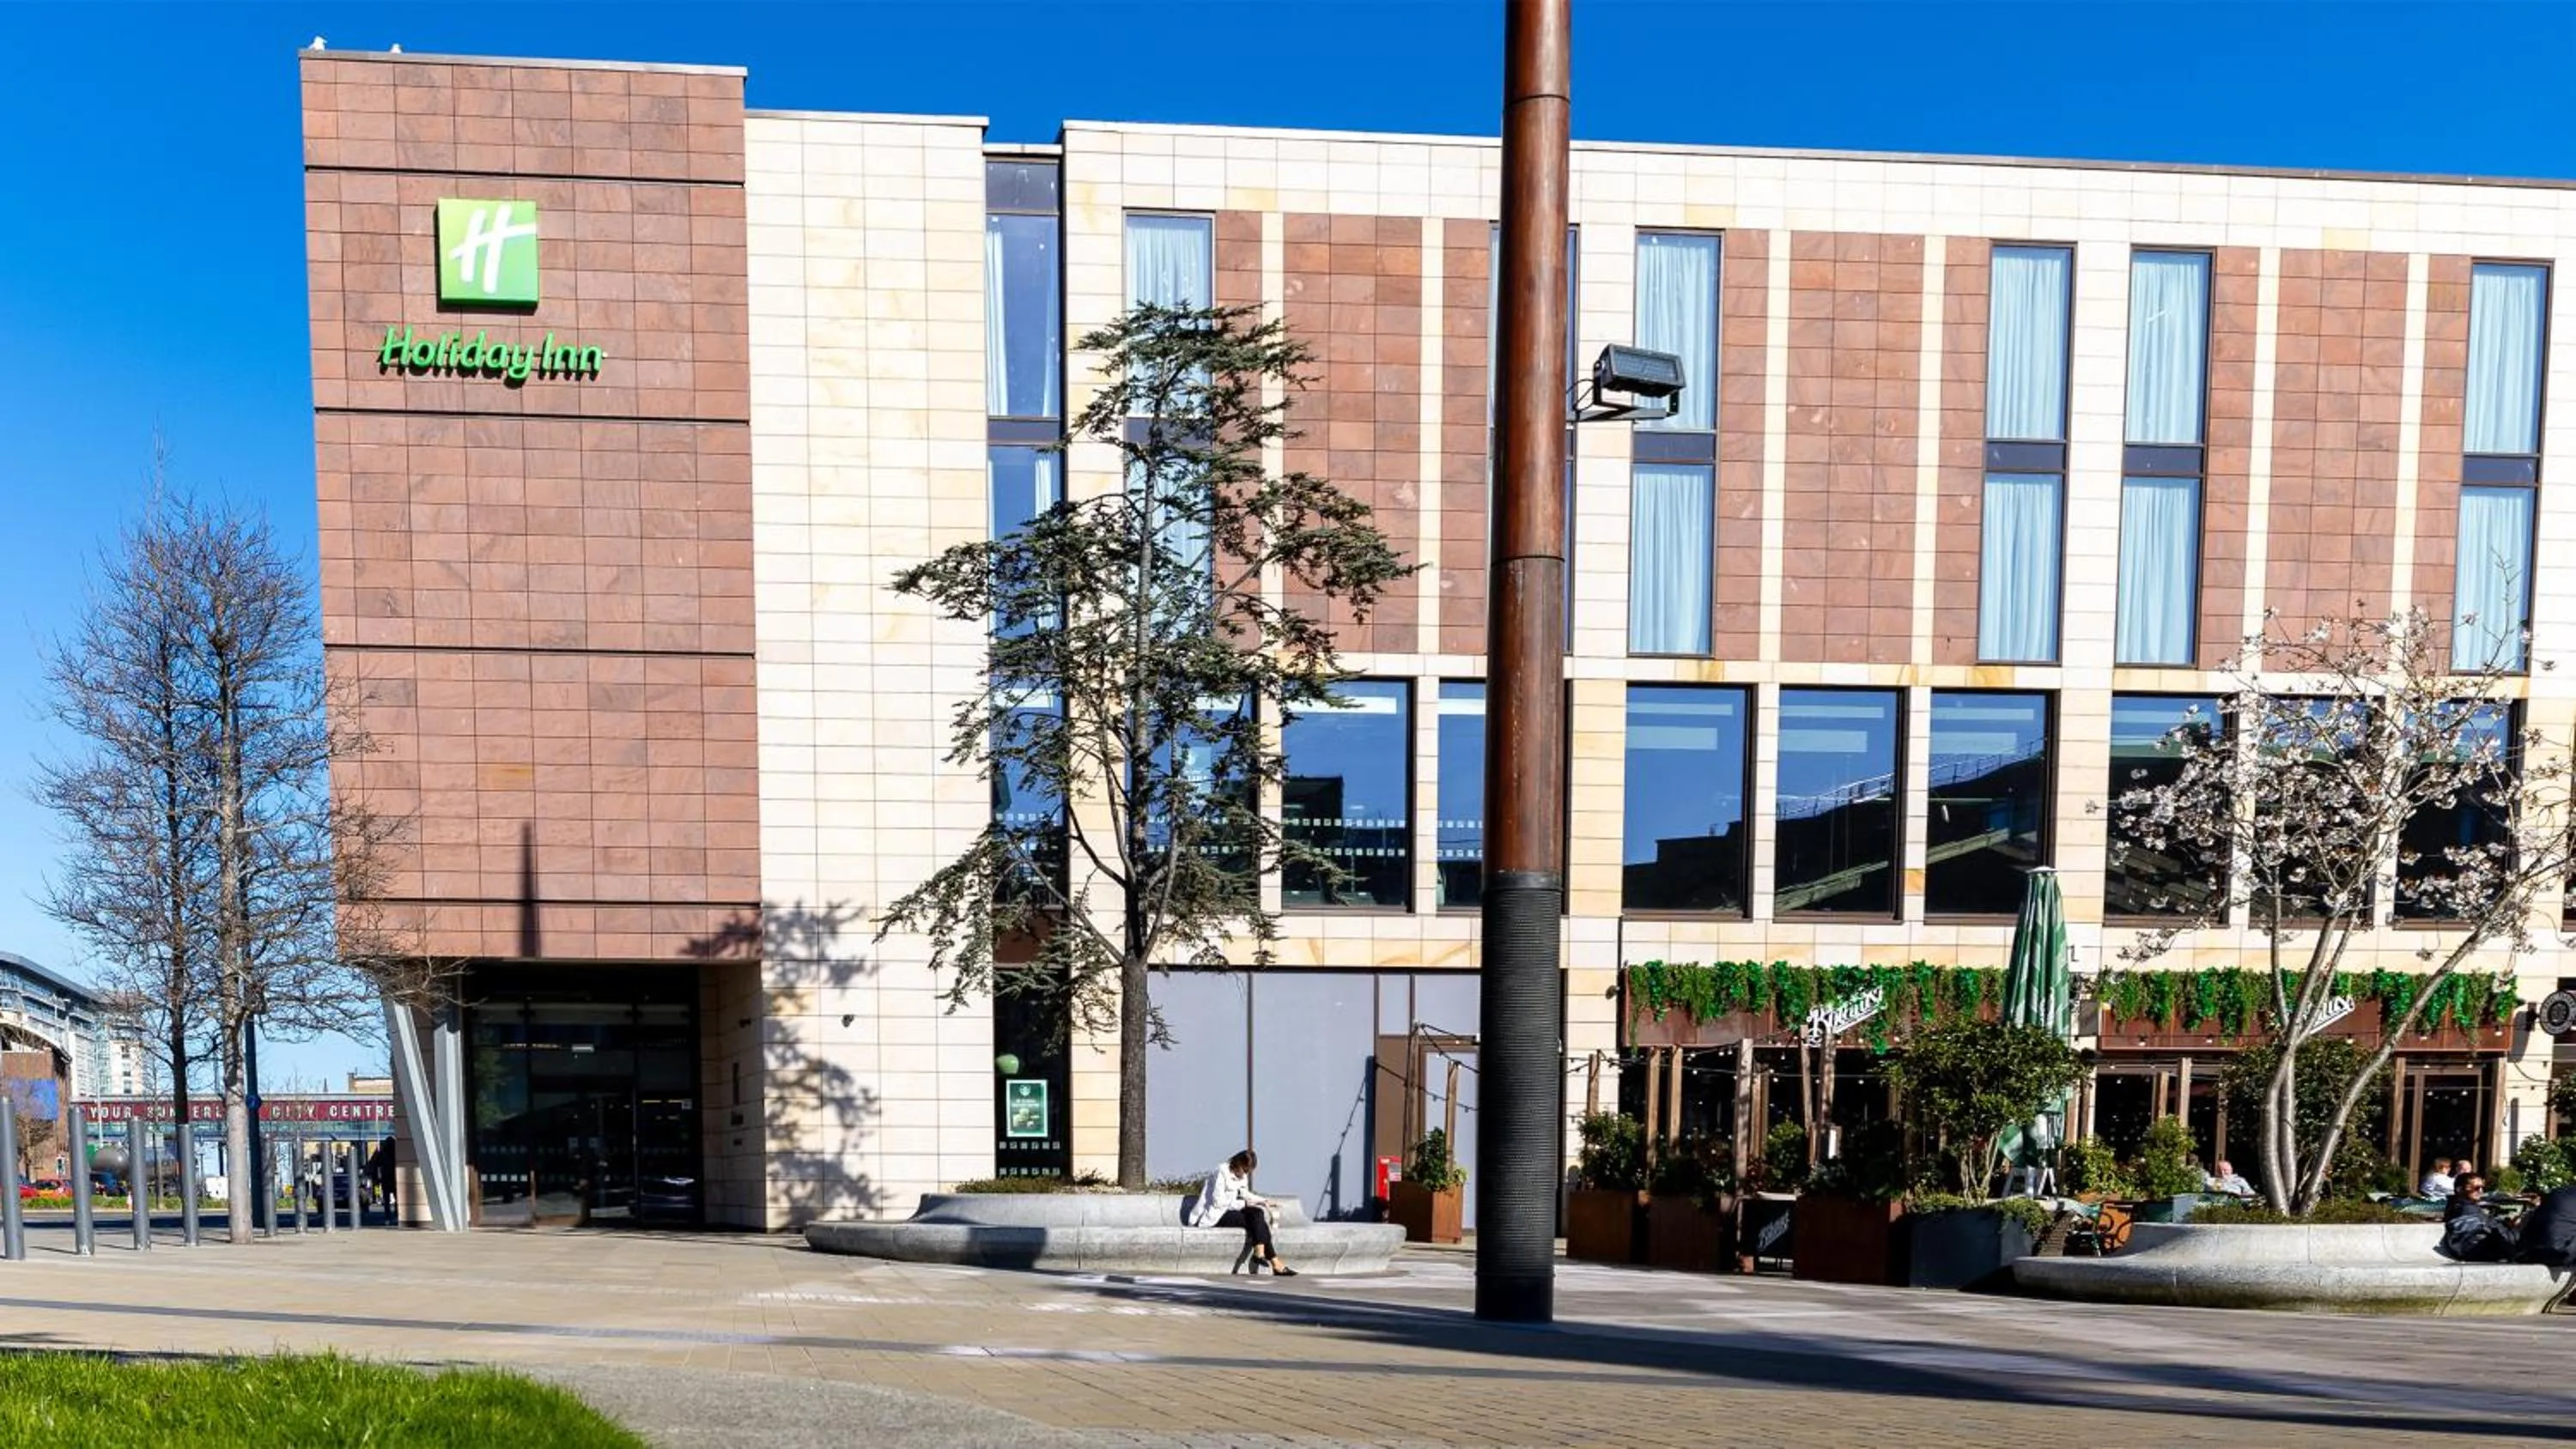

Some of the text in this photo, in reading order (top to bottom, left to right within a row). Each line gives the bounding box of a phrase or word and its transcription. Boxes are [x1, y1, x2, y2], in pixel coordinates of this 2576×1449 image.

[380, 324, 603, 379] Holiday Inn
[89, 1106, 131, 1119] YOUR
[271, 1105, 315, 1118] CITY
[329, 1105, 394, 1118] CENTRE
